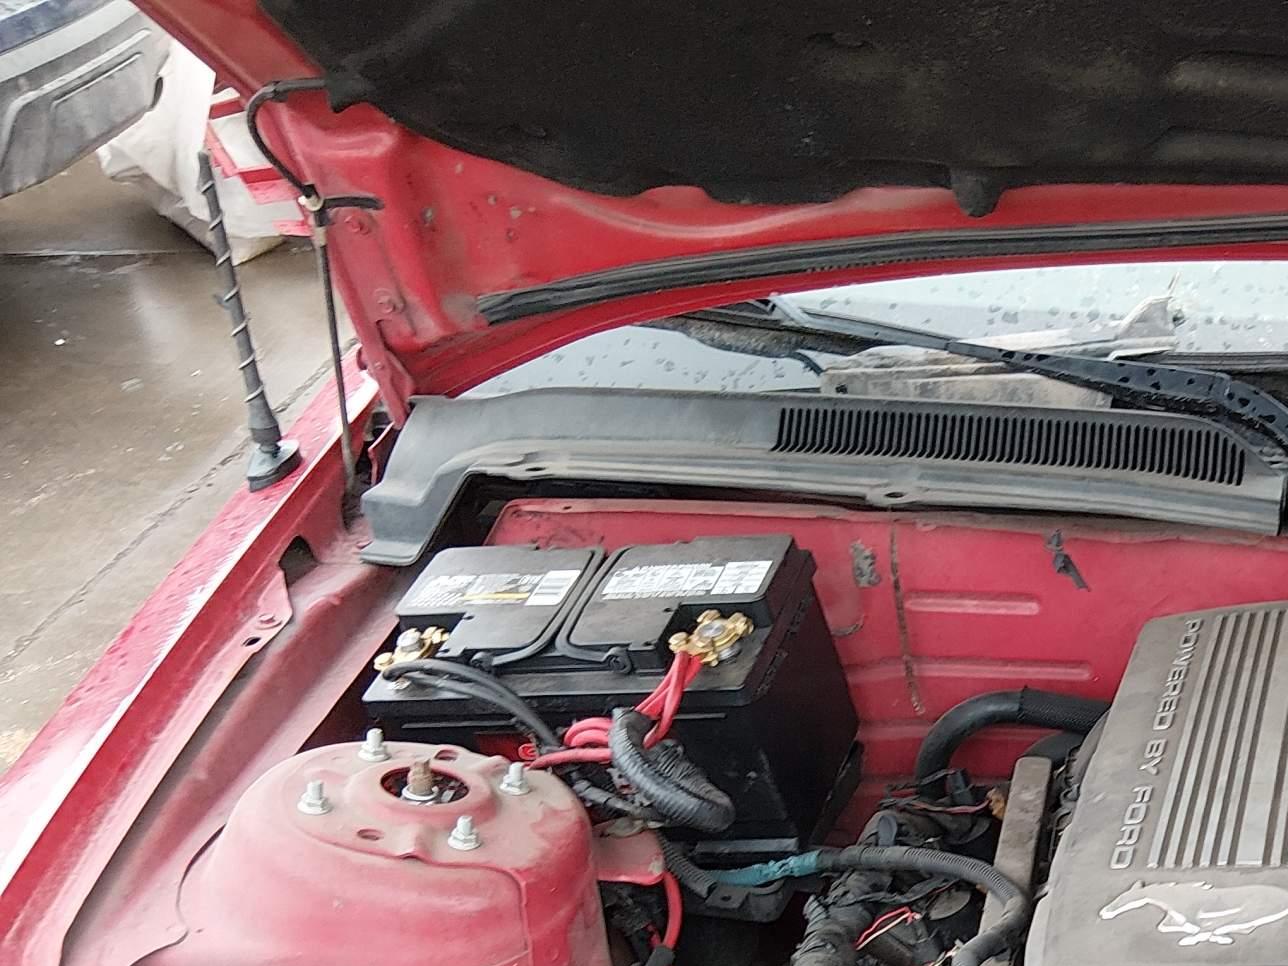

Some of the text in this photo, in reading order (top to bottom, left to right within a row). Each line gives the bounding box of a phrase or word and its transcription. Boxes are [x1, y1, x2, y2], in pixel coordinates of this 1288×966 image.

[1110, 619, 1203, 870] POWERED BY FORD
